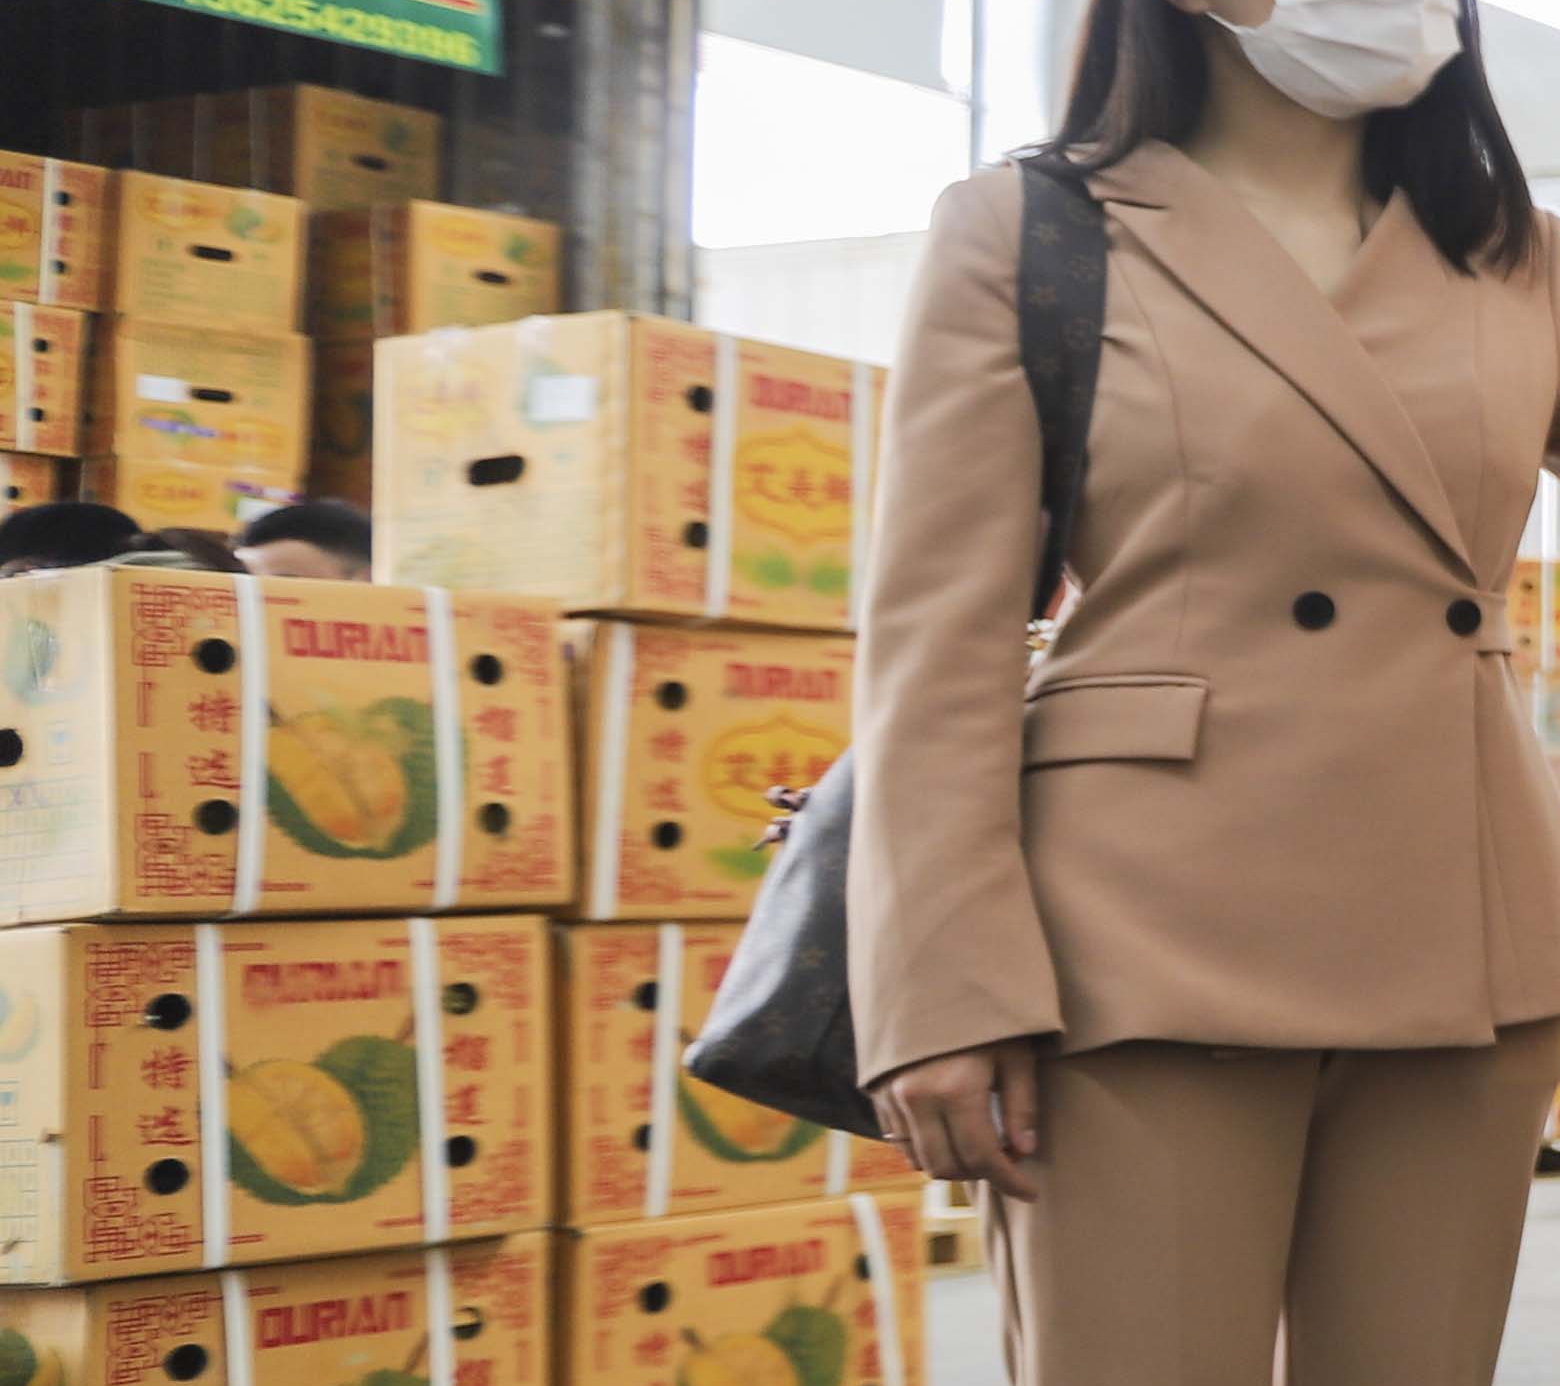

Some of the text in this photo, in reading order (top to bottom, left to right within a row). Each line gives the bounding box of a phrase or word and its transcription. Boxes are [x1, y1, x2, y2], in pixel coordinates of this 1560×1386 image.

[188, 693, 241, 790] 特选
[136, 1046, 195, 1146] 特选
[255, 1290, 412, 1350] DURIAN
